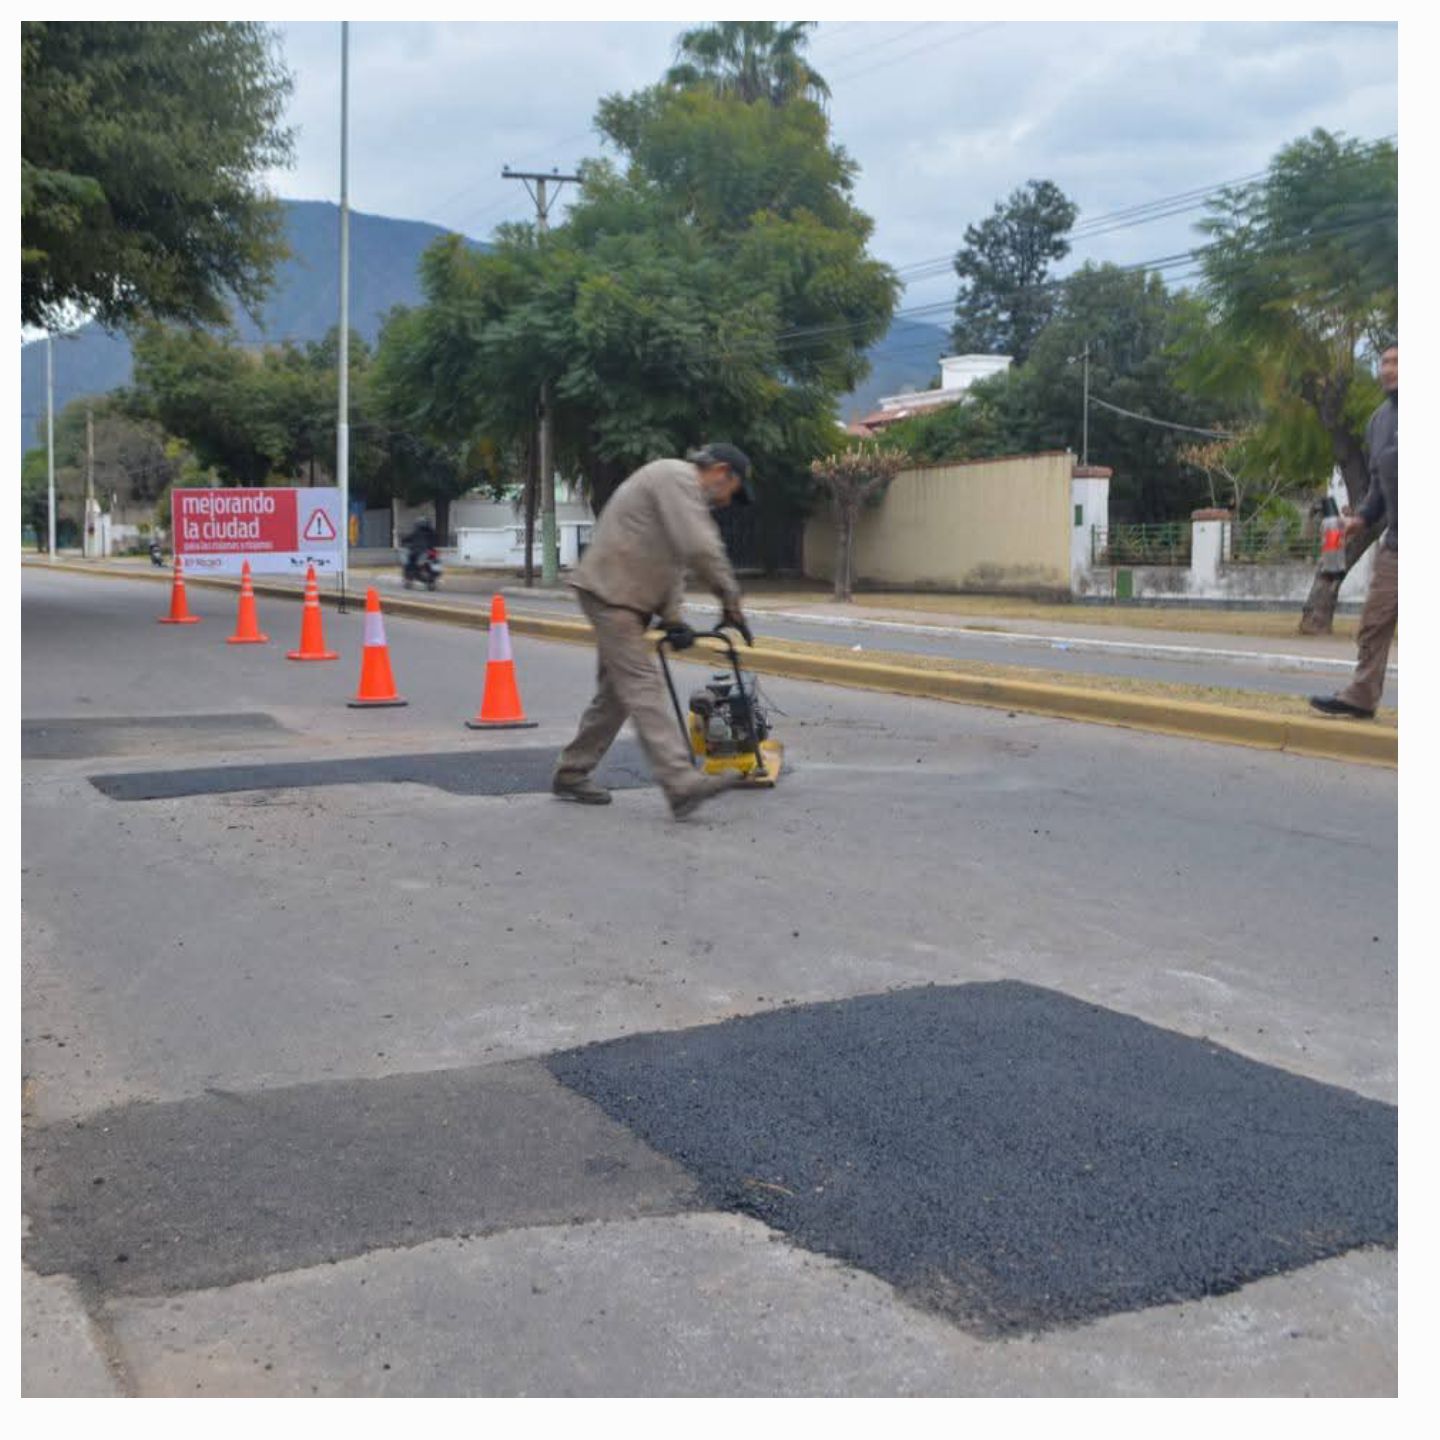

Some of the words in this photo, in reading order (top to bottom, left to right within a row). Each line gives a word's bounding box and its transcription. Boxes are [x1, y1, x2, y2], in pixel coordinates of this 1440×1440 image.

[182, 491, 275, 517] mejorando
[183, 516, 200, 539] la
[203, 516, 260, 539] ciudad
